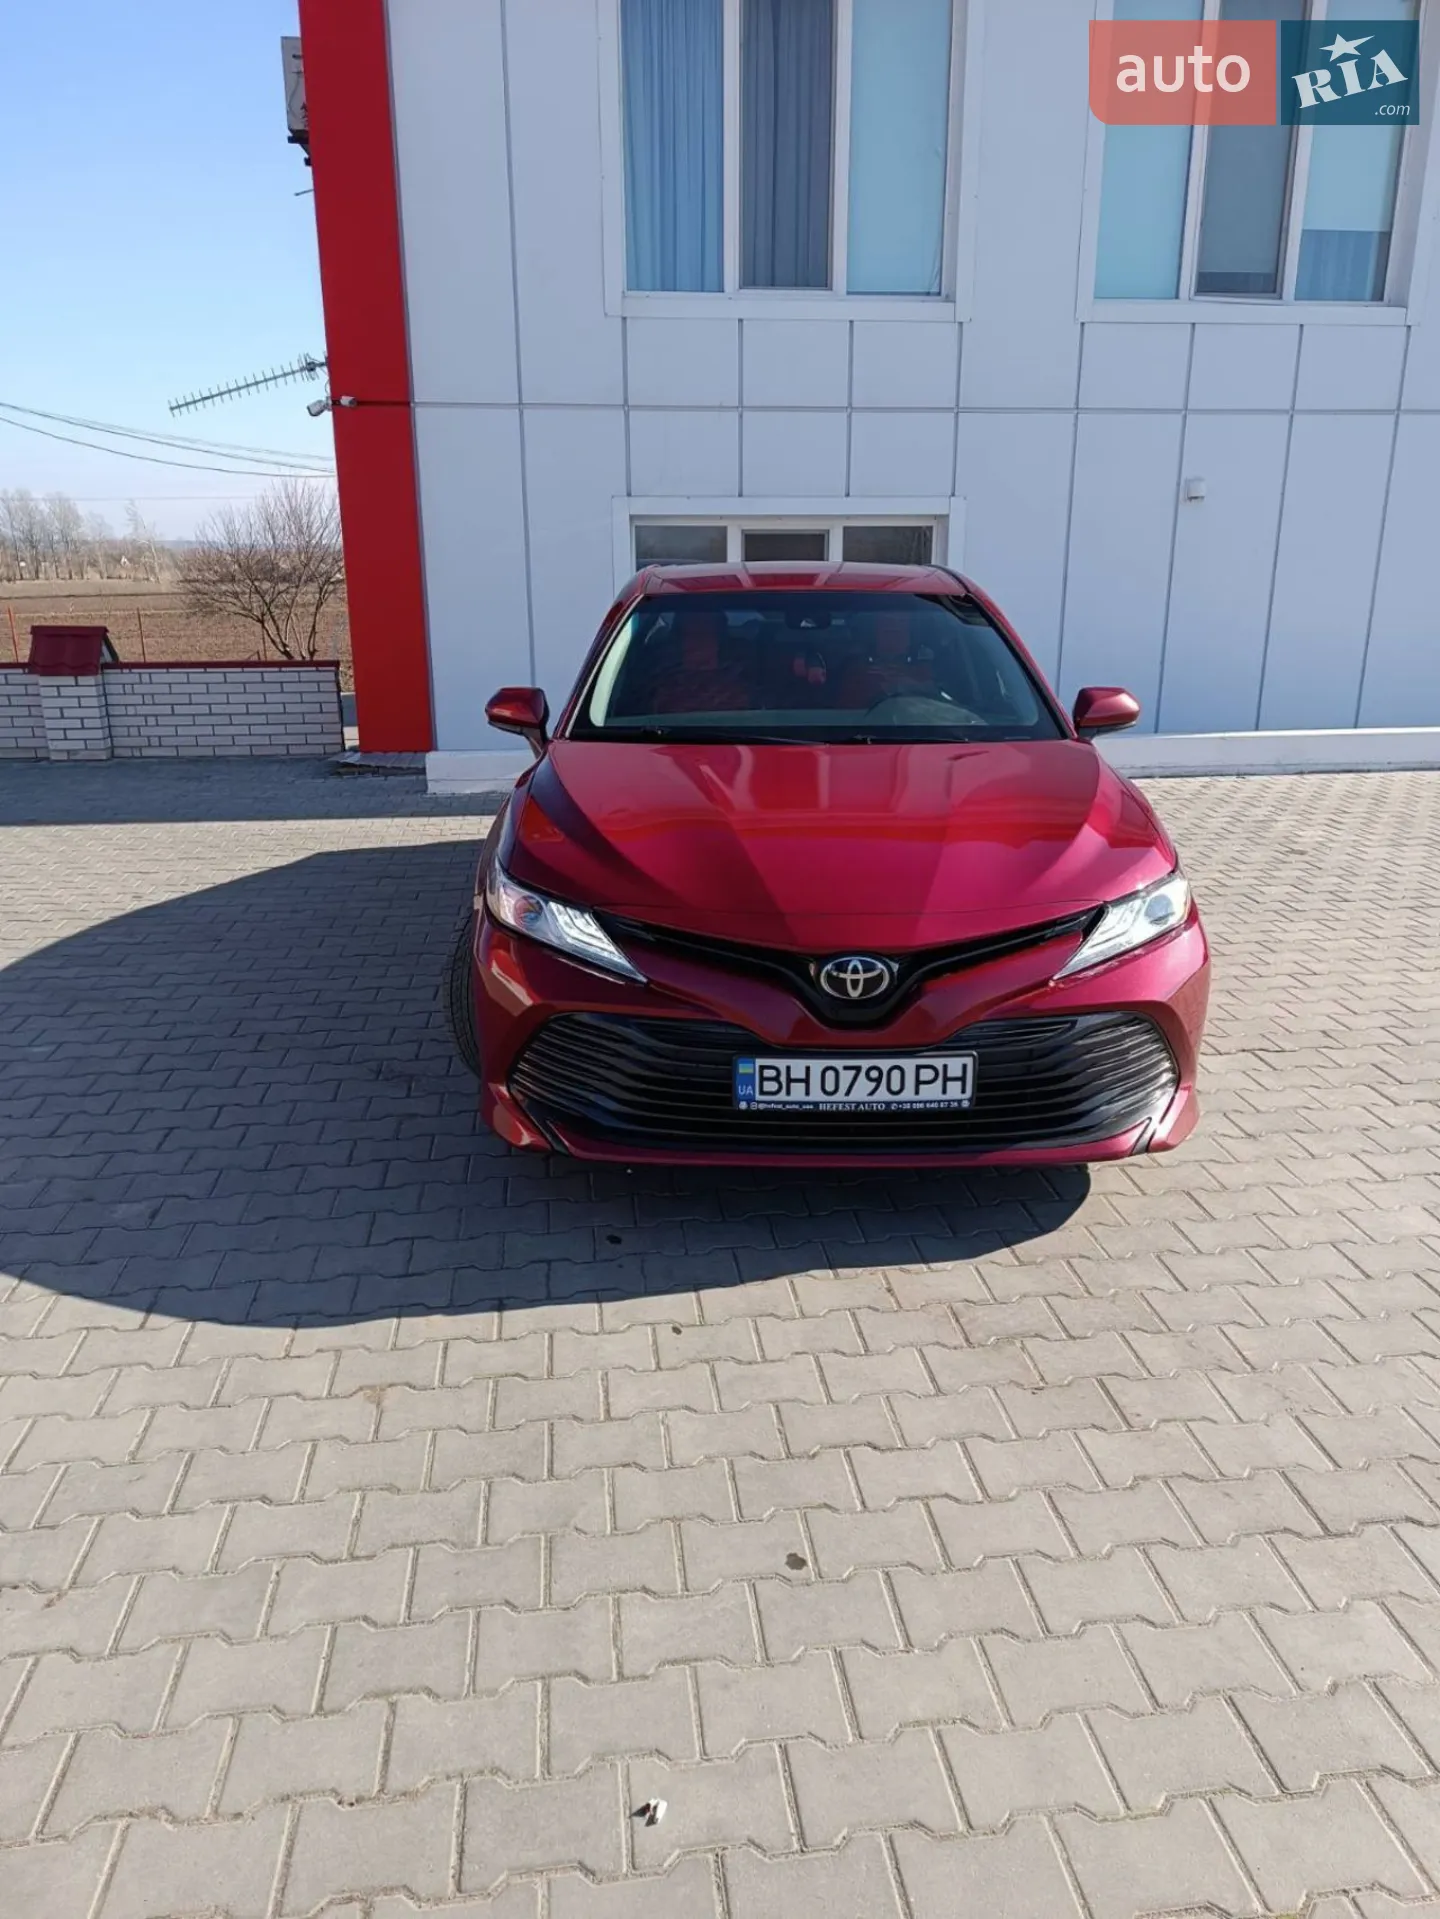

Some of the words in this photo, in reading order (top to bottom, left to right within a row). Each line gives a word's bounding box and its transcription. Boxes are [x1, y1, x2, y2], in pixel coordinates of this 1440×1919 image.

[758, 1064, 811, 1097] BH
[820, 1064, 906, 1097] 0790
[914, 1063, 968, 1097] PH
[738, 1086, 754, 1096] UA
[819, 1103, 856, 1111] HEFEST
[857, 1102, 886, 1111] AUTO
